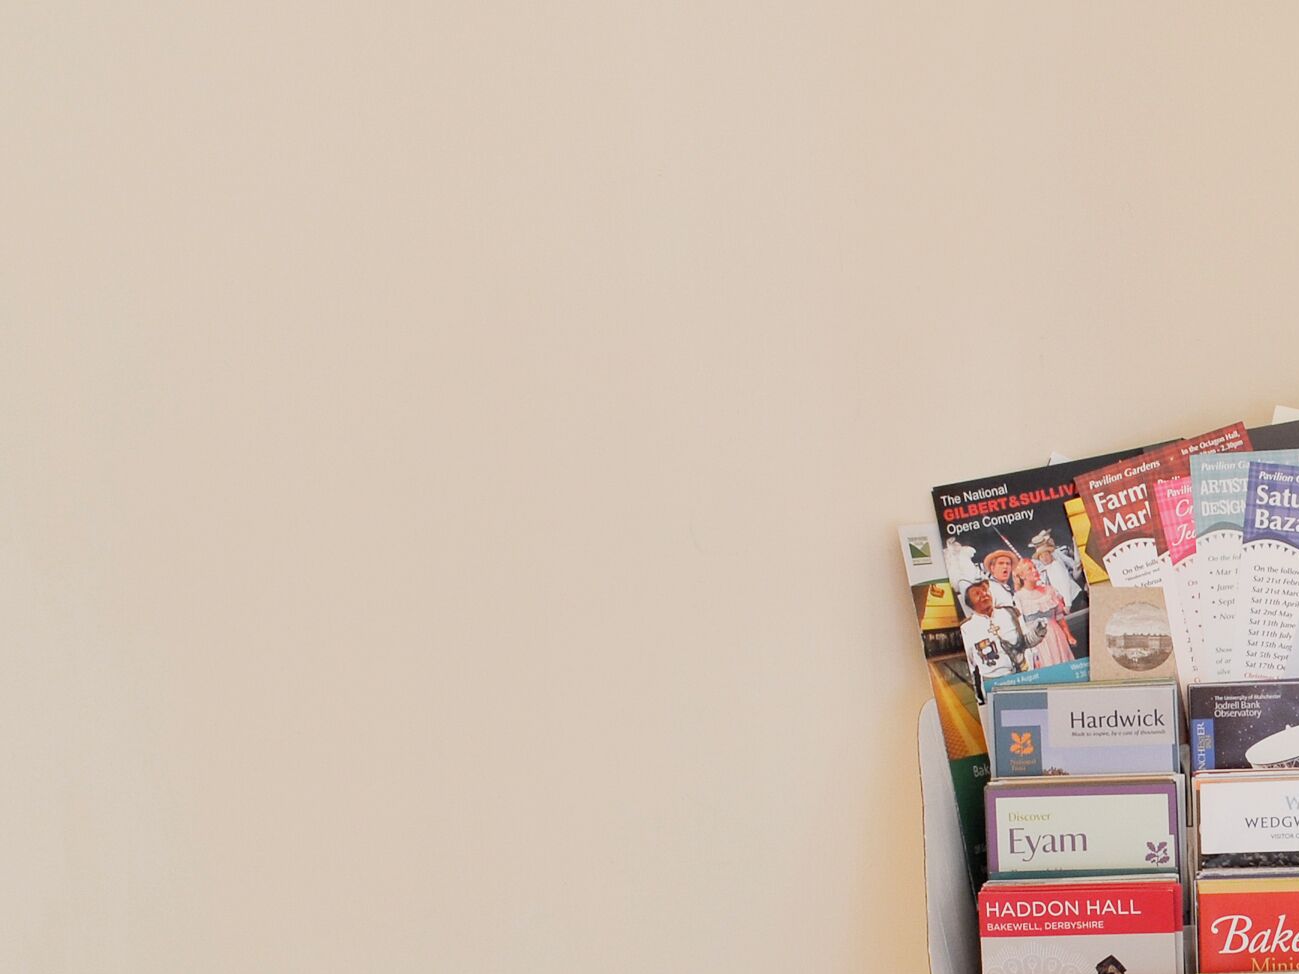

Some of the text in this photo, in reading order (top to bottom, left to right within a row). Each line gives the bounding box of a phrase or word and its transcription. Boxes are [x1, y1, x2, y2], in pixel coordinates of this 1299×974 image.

[1199, 436, 1225, 450] Octagon
[1201, 460, 1235, 471] Pavilion
[1089, 460, 1160, 490] Pavilion Gardens
[1259, 471, 1293, 483] Pavilion
[941, 484, 1008, 507] The National
[946, 509, 1034, 536] Opera Company
[1282, 600, 1299, 608] April
[1214, 700, 1261, 710] Jodrell Bank
[1070, 709, 1166, 729] Hardwick
[1214, 709, 1262, 719] Observatory
[1008, 811, 1051, 823] Discover
[1271, 832, 1294, 840] VISITOR
[1008, 827, 1088, 862] Eyam
[986, 899, 1142, 918] HADDON HALL
[986, 920, 1104, 932] BAKEWELL, DERBYSHIRE
